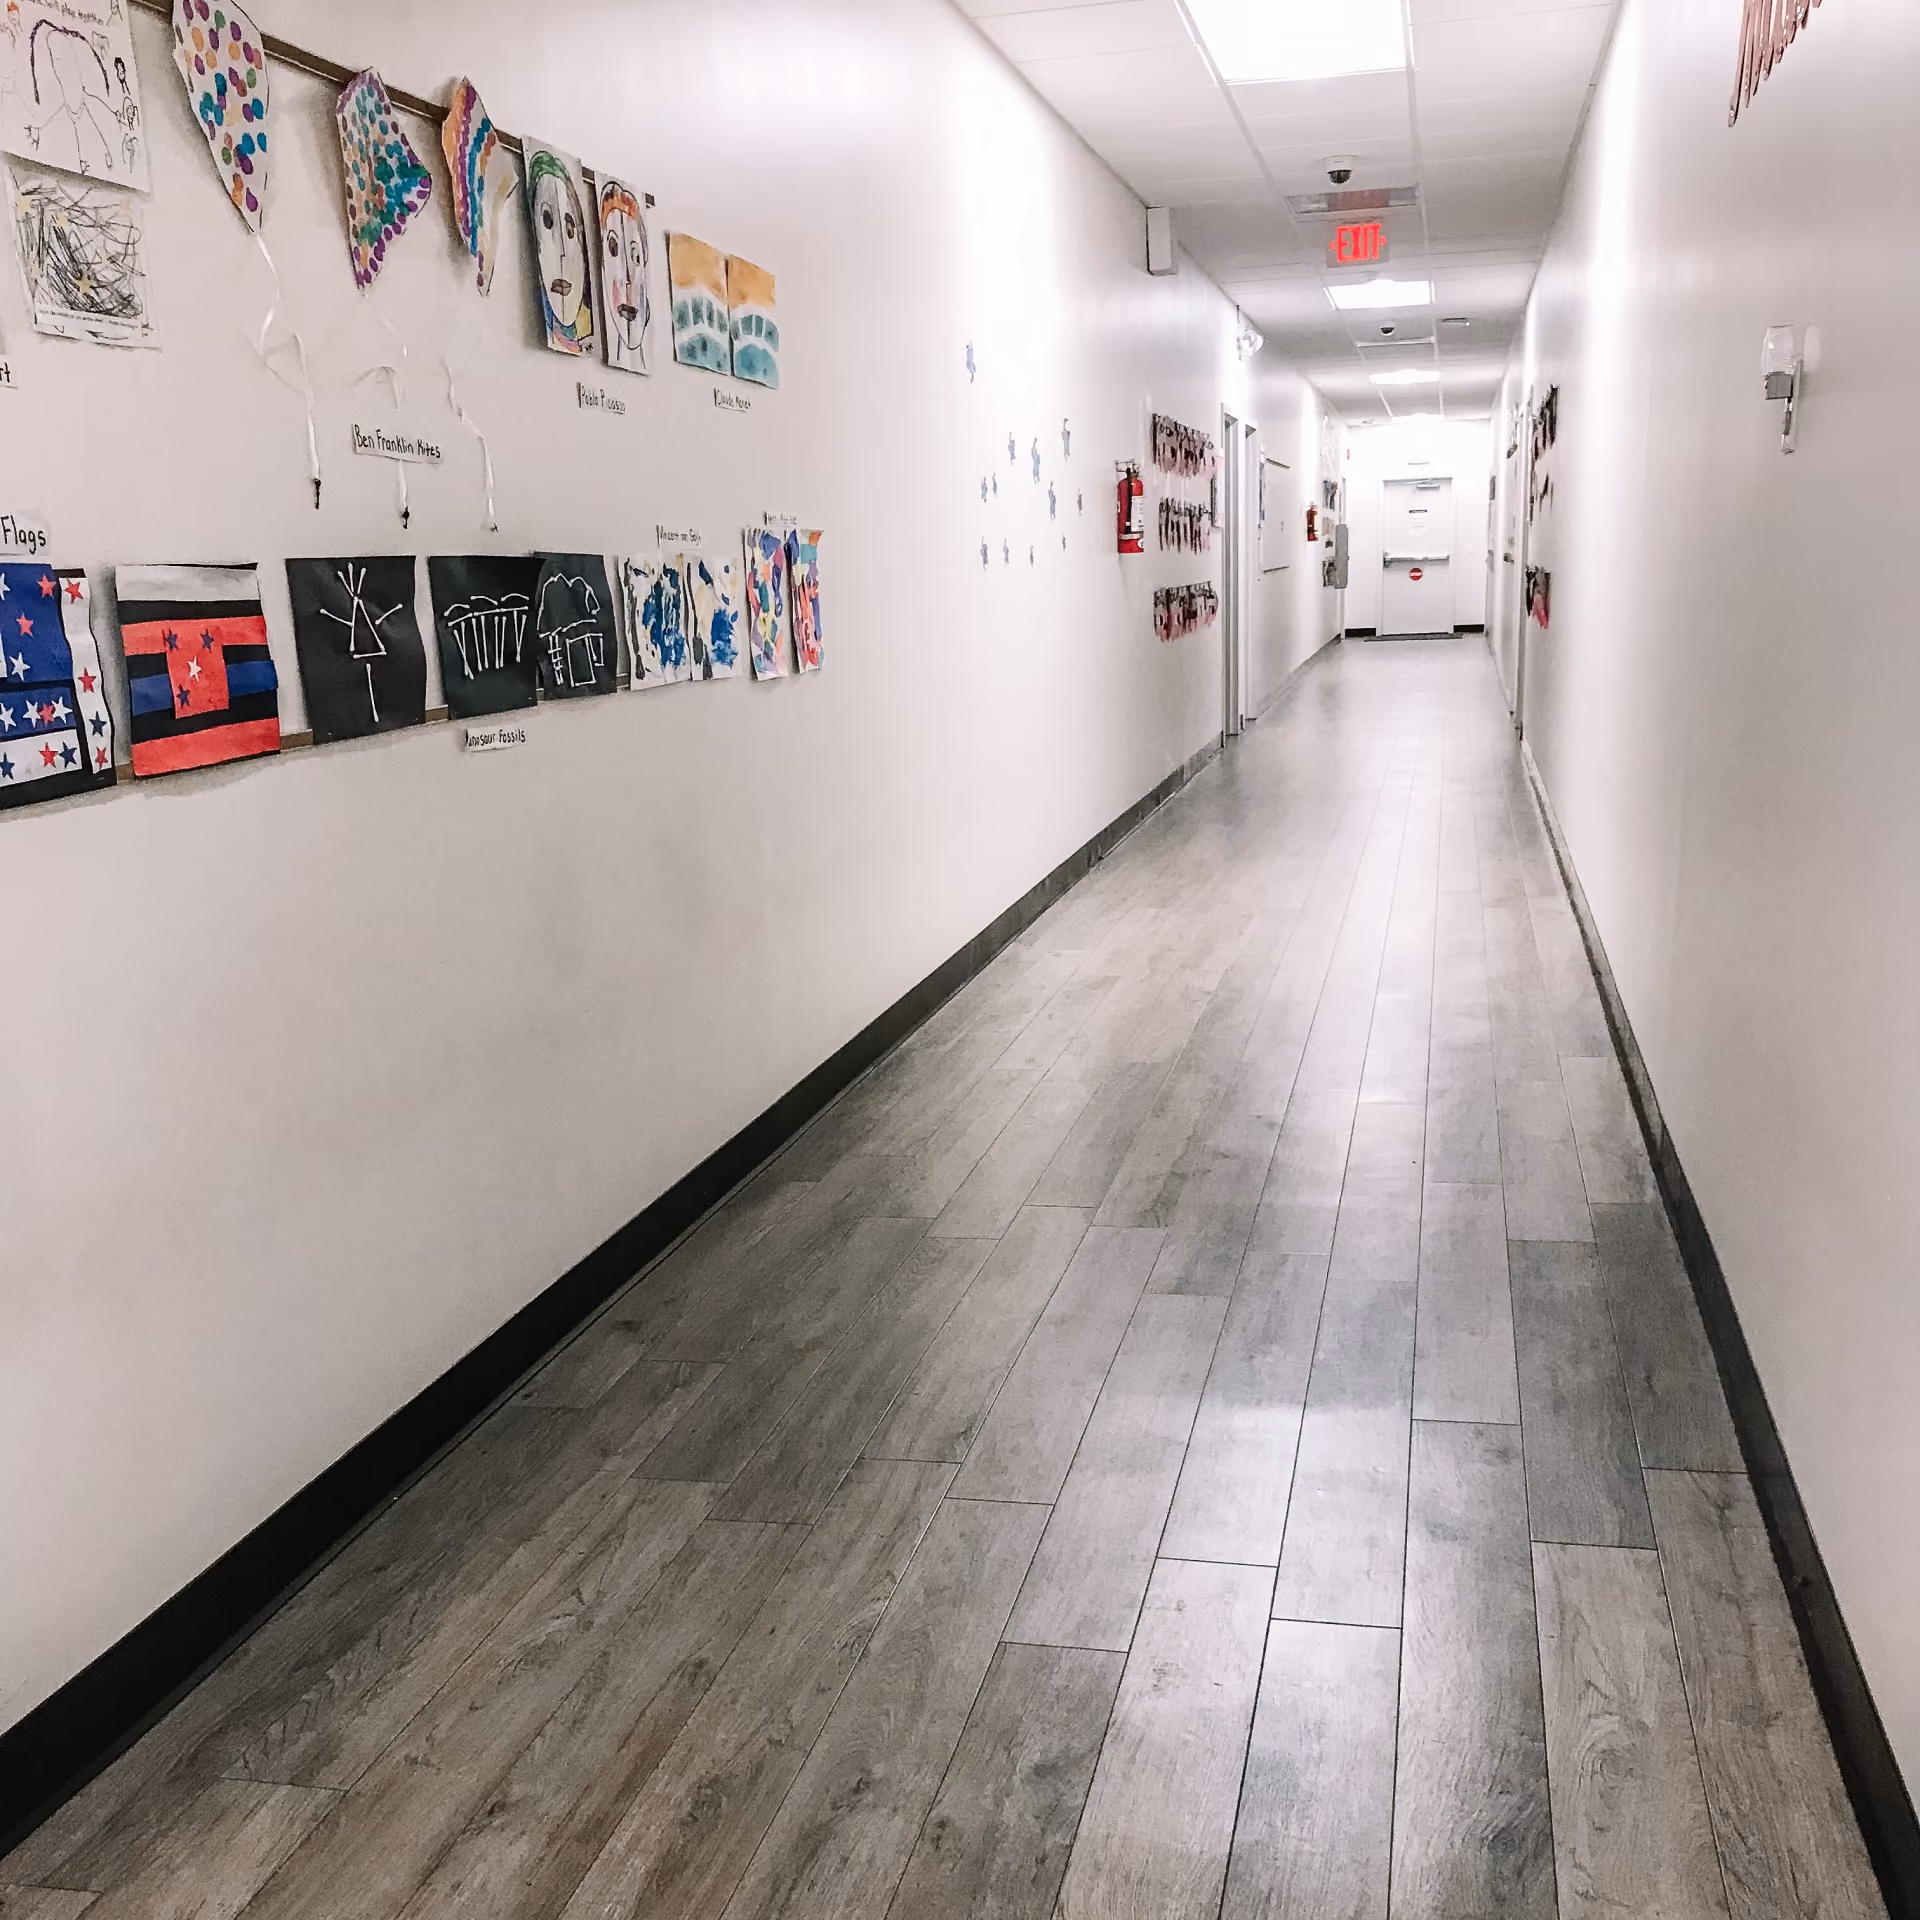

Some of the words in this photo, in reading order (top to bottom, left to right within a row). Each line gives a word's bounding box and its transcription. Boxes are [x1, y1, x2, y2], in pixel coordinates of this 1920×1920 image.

[1336, 223, 1381, 262] EXIT
[354, 423, 375, 449] Ben
[376, 428, 414, 454] Franklin
[417, 438, 441, 458] Kites
[0, 514, 47, 555] Flags
[499, 728, 526, 744] Fossils
